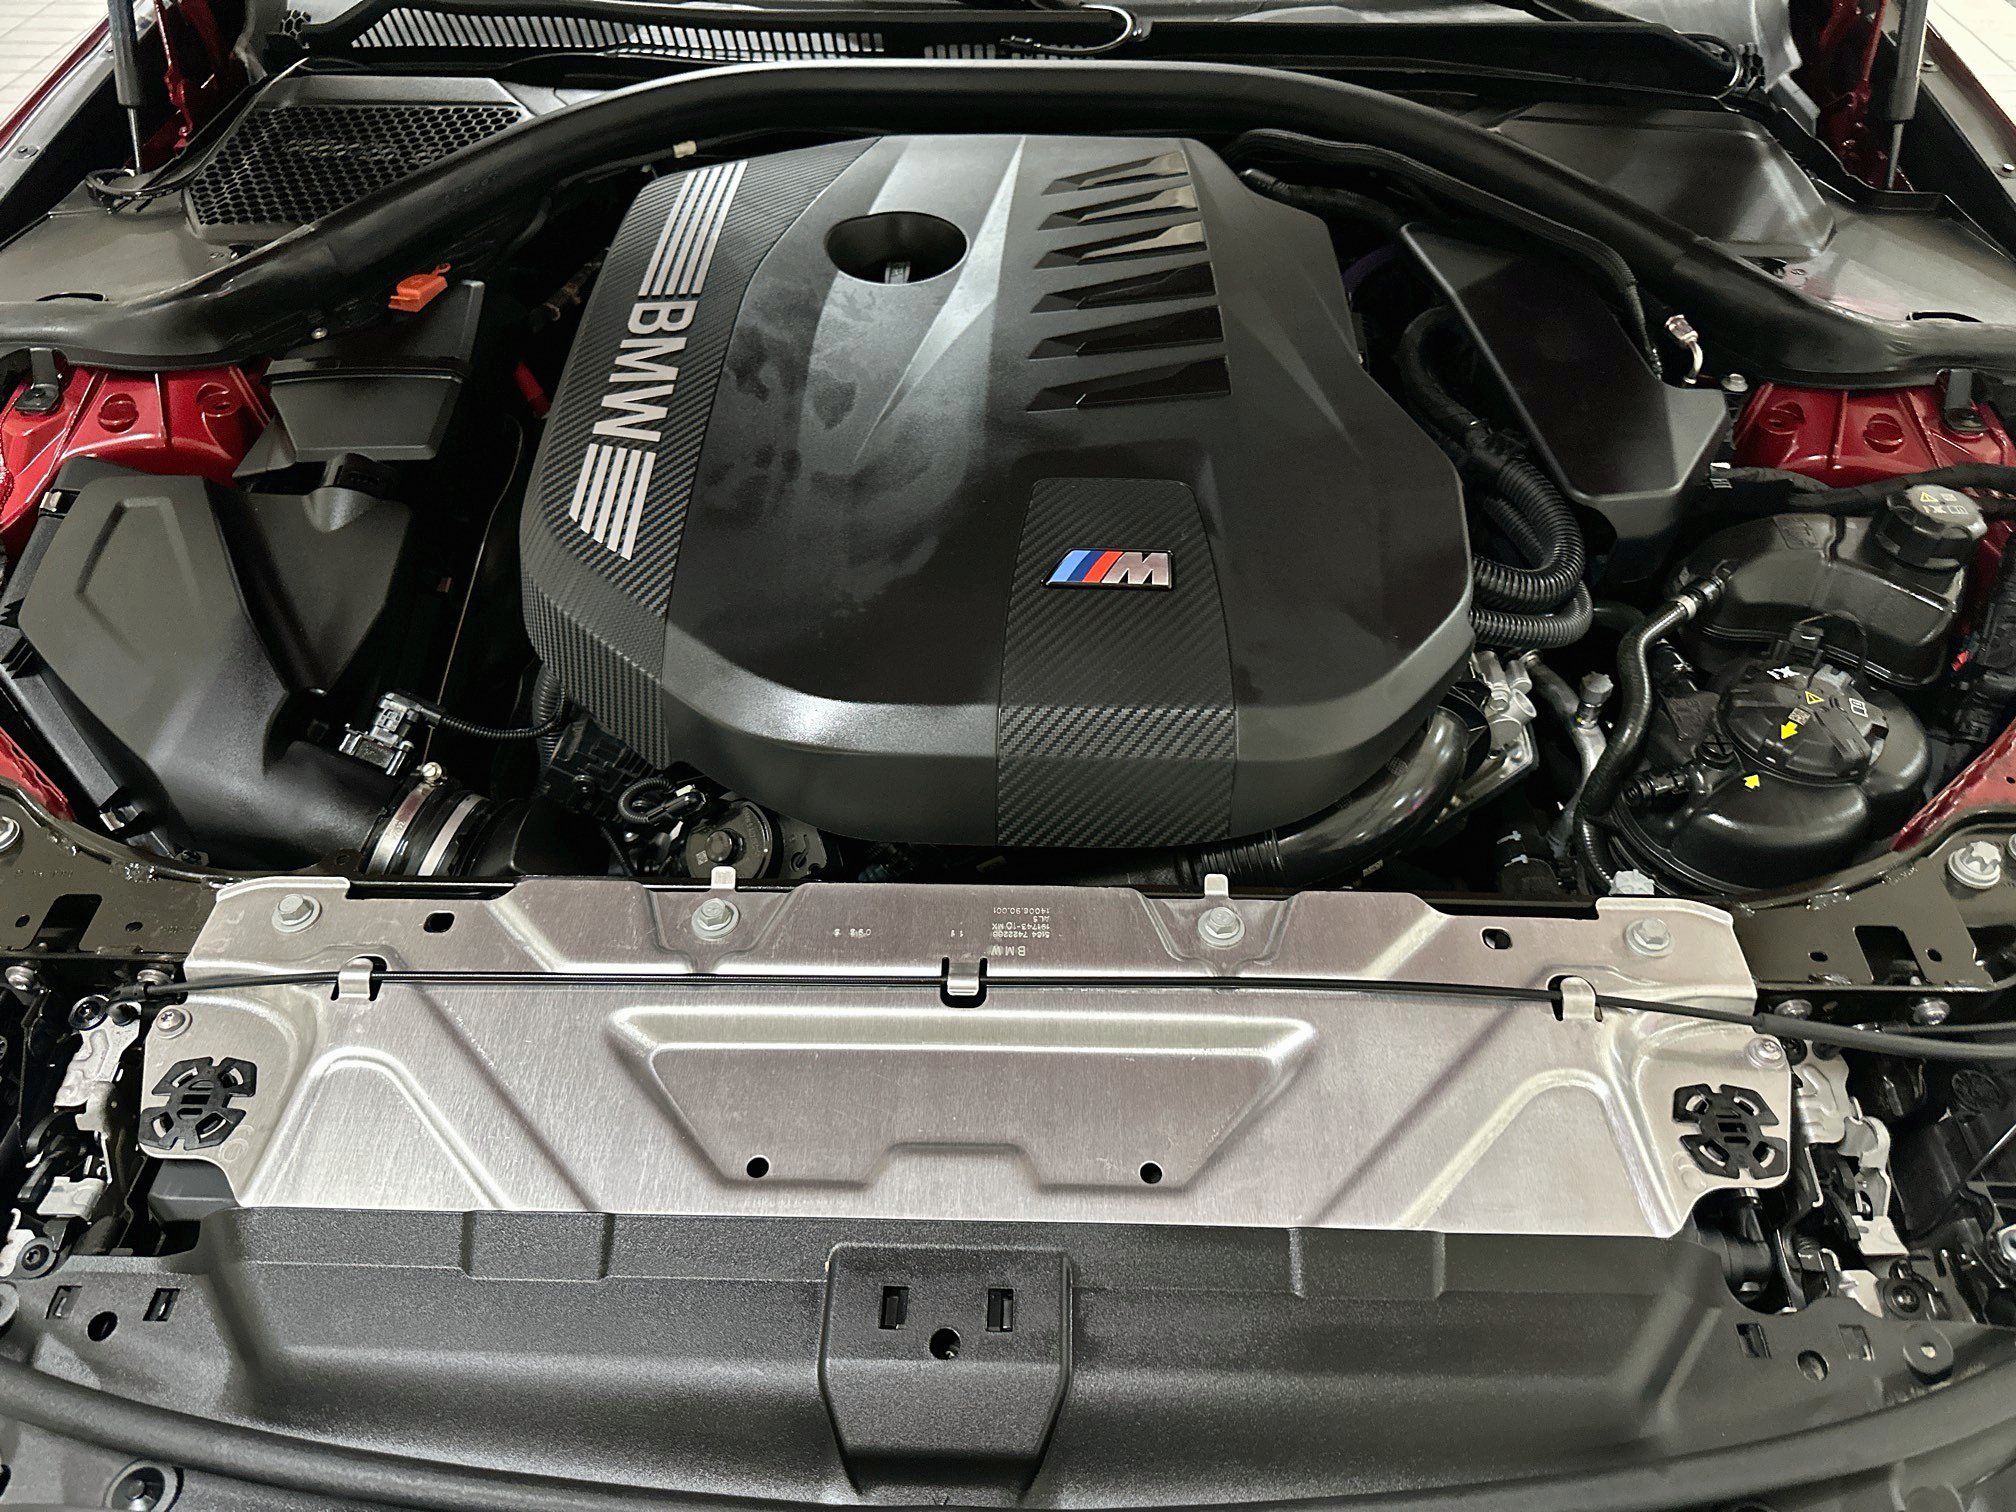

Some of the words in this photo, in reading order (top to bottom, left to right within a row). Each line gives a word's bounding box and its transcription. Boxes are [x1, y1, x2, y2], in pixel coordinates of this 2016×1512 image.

[592, 300, 699, 442] BMW
[1101, 551, 1169, 585] M
[990, 945, 1026, 957] BMW
